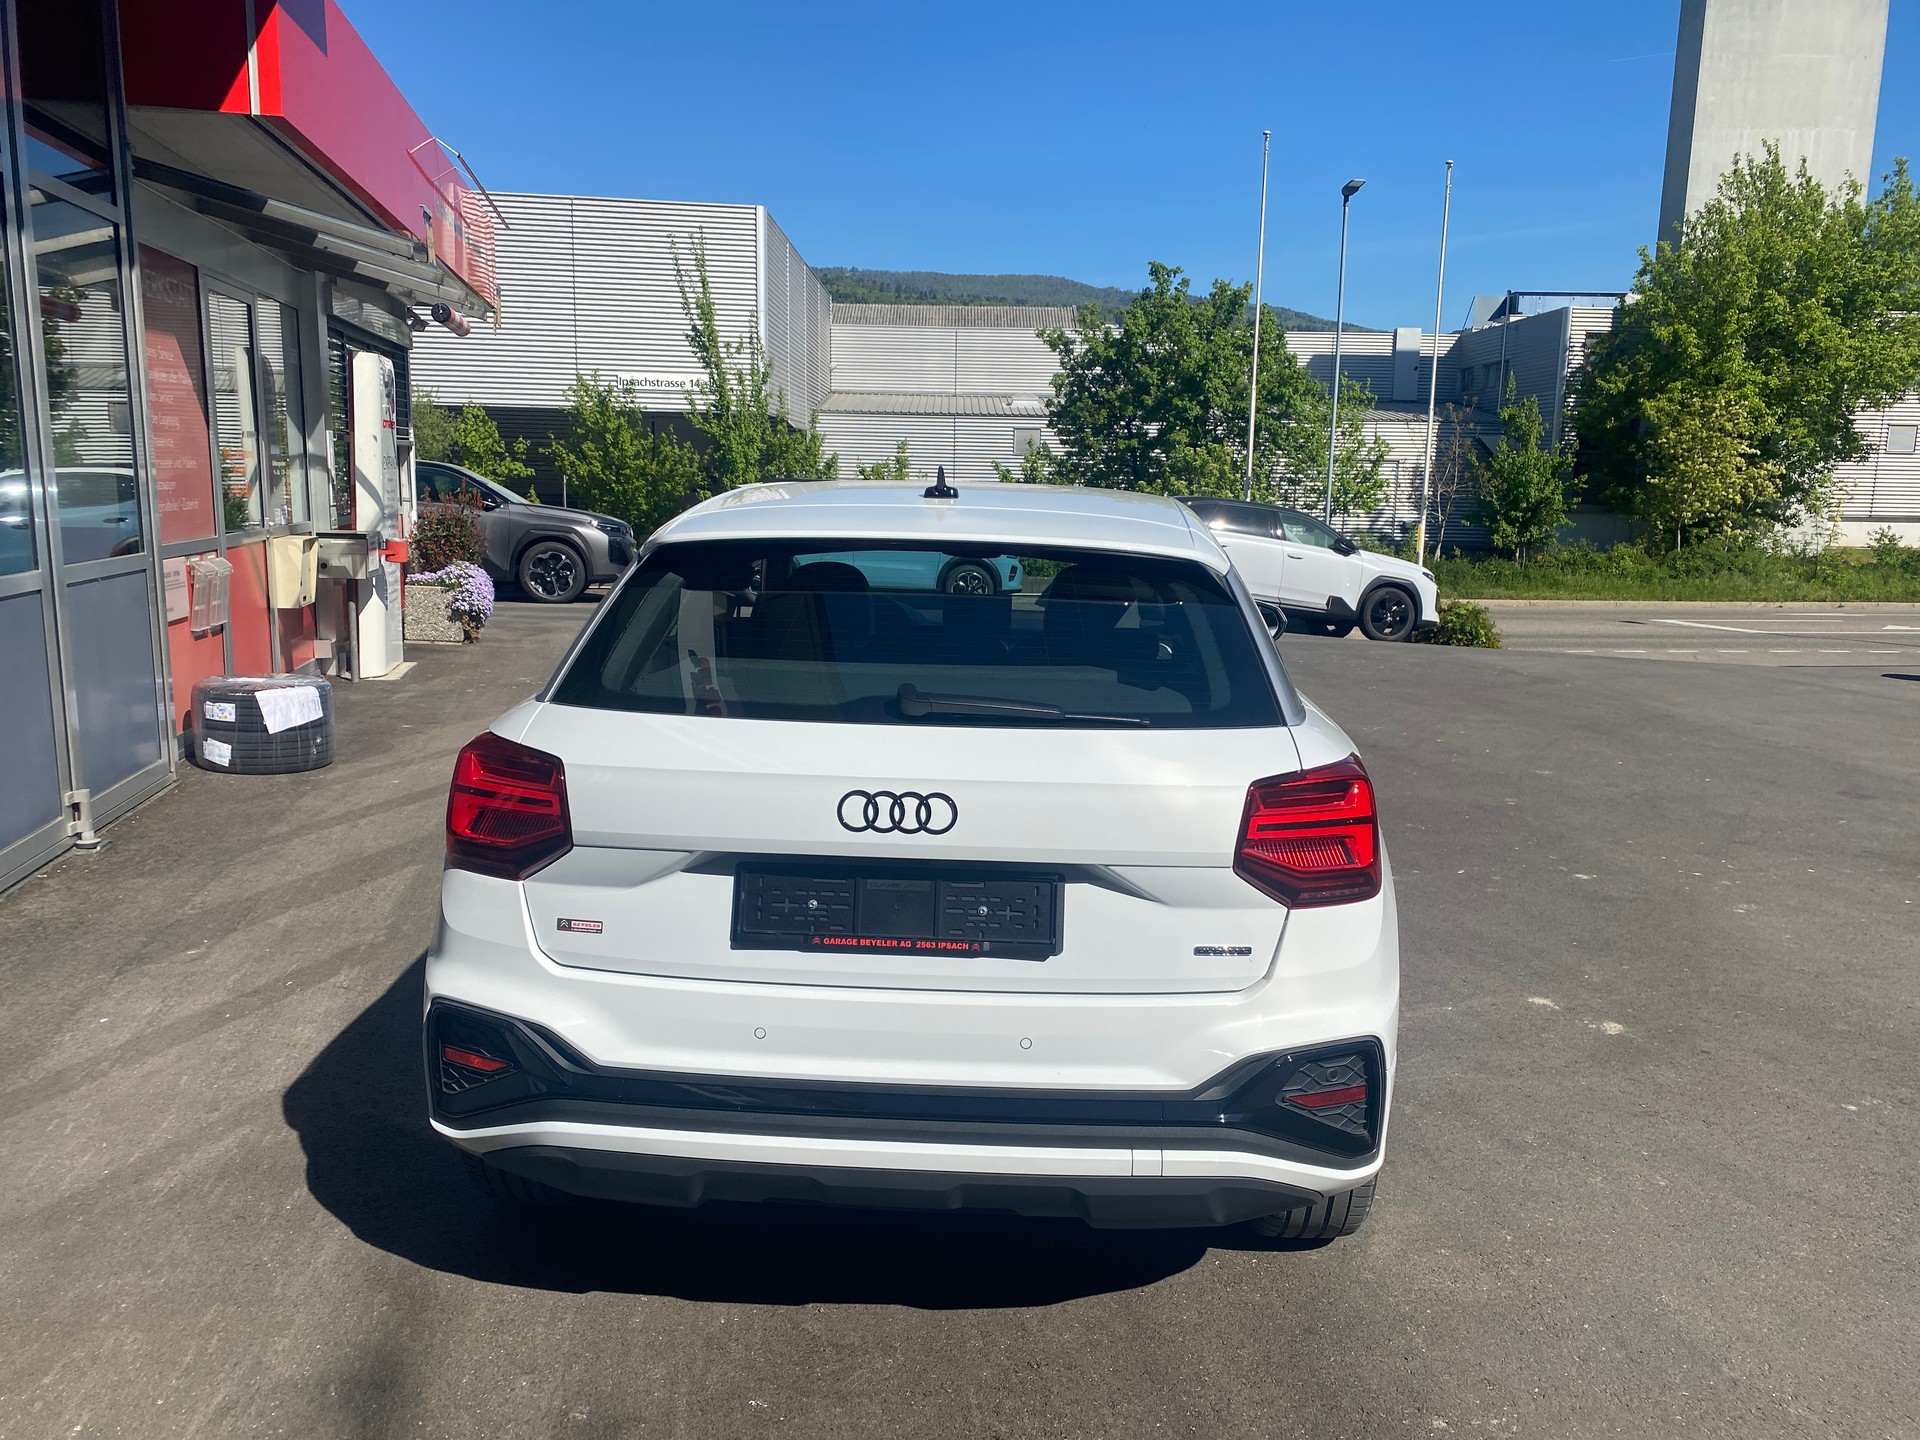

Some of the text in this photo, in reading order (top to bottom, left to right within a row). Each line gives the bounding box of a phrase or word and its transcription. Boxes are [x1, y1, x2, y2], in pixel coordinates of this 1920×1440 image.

[619, 376, 686, 389] Ipsachstrasse
[823, 937, 969, 950] GARAGE BEYELER AG 2563 IPSACH
